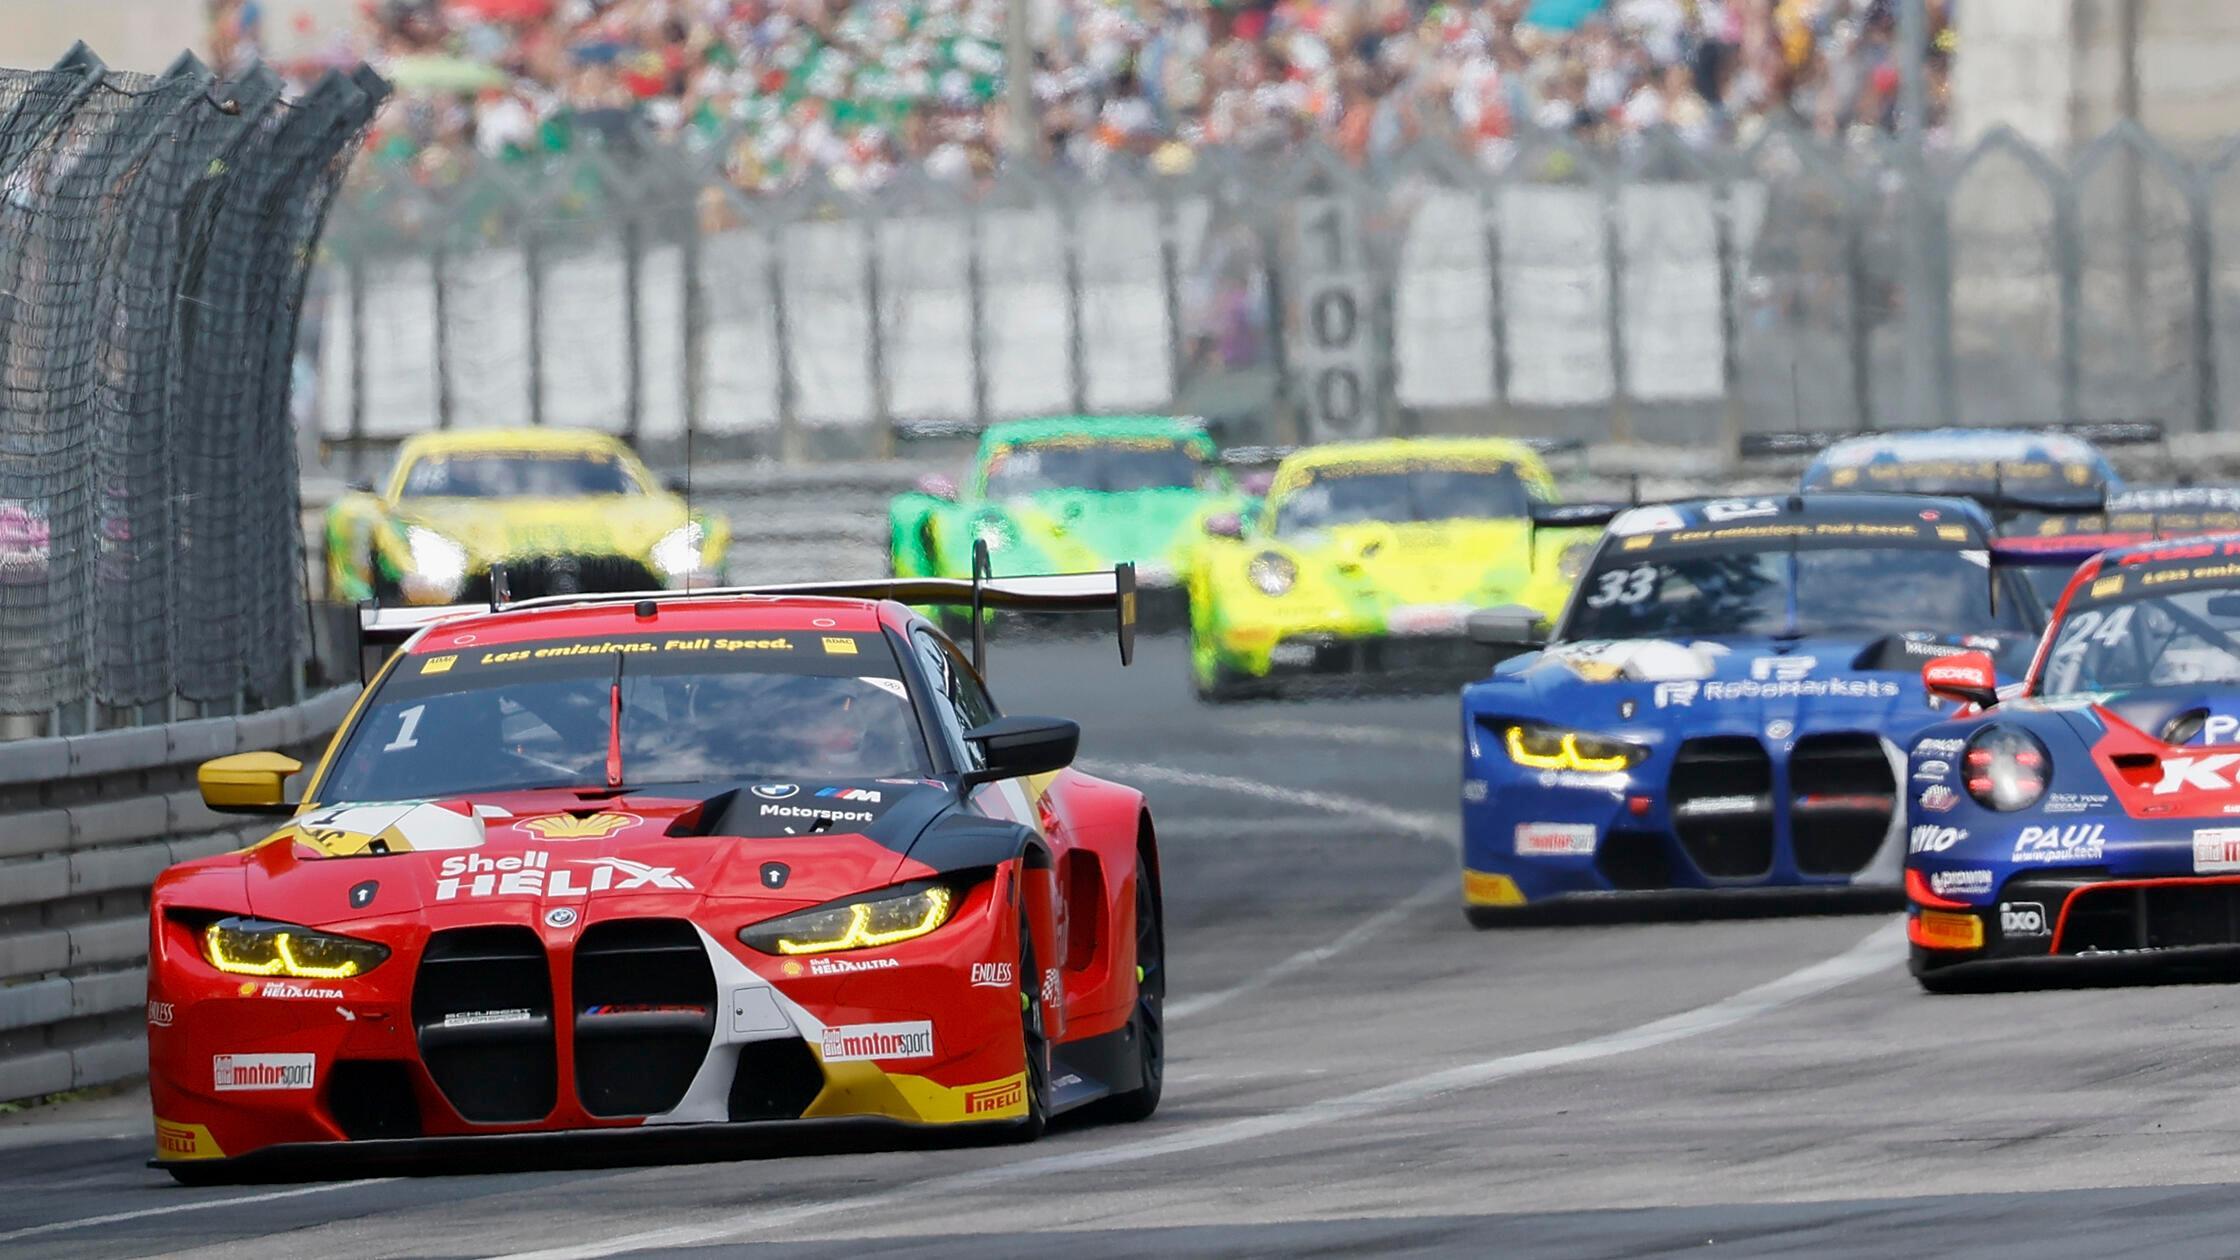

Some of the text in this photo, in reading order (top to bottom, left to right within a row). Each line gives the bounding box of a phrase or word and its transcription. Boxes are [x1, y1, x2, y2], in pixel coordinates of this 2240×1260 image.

[1307, 208, 1361, 431] 100
[1586, 566, 1658, 609] 33
[825, 638, 853, 646] ADAC
[2056, 605, 2136, 656] 24
[480, 638, 794, 665] Less emissions. Full Speed.
[1704, 677, 1900, 701] RoboMarkets
[383, 704, 426, 752] 1
[759, 803, 874, 822] Motorsport
[2014, 824, 2107, 850] PAUL
[440, 850, 549, 876] Shell
[435, 857, 695, 901] HELIX
[811, 958, 900, 975] HELIX ULTRA
[970, 962, 1012, 985] ENDLESS
[262, 984, 345, 999] HELIX ULTRA
[843, 1030, 932, 1057] motorsport
[233, 1061, 313, 1087] motorsport
[964, 1081, 1022, 1114] PIRELLI
